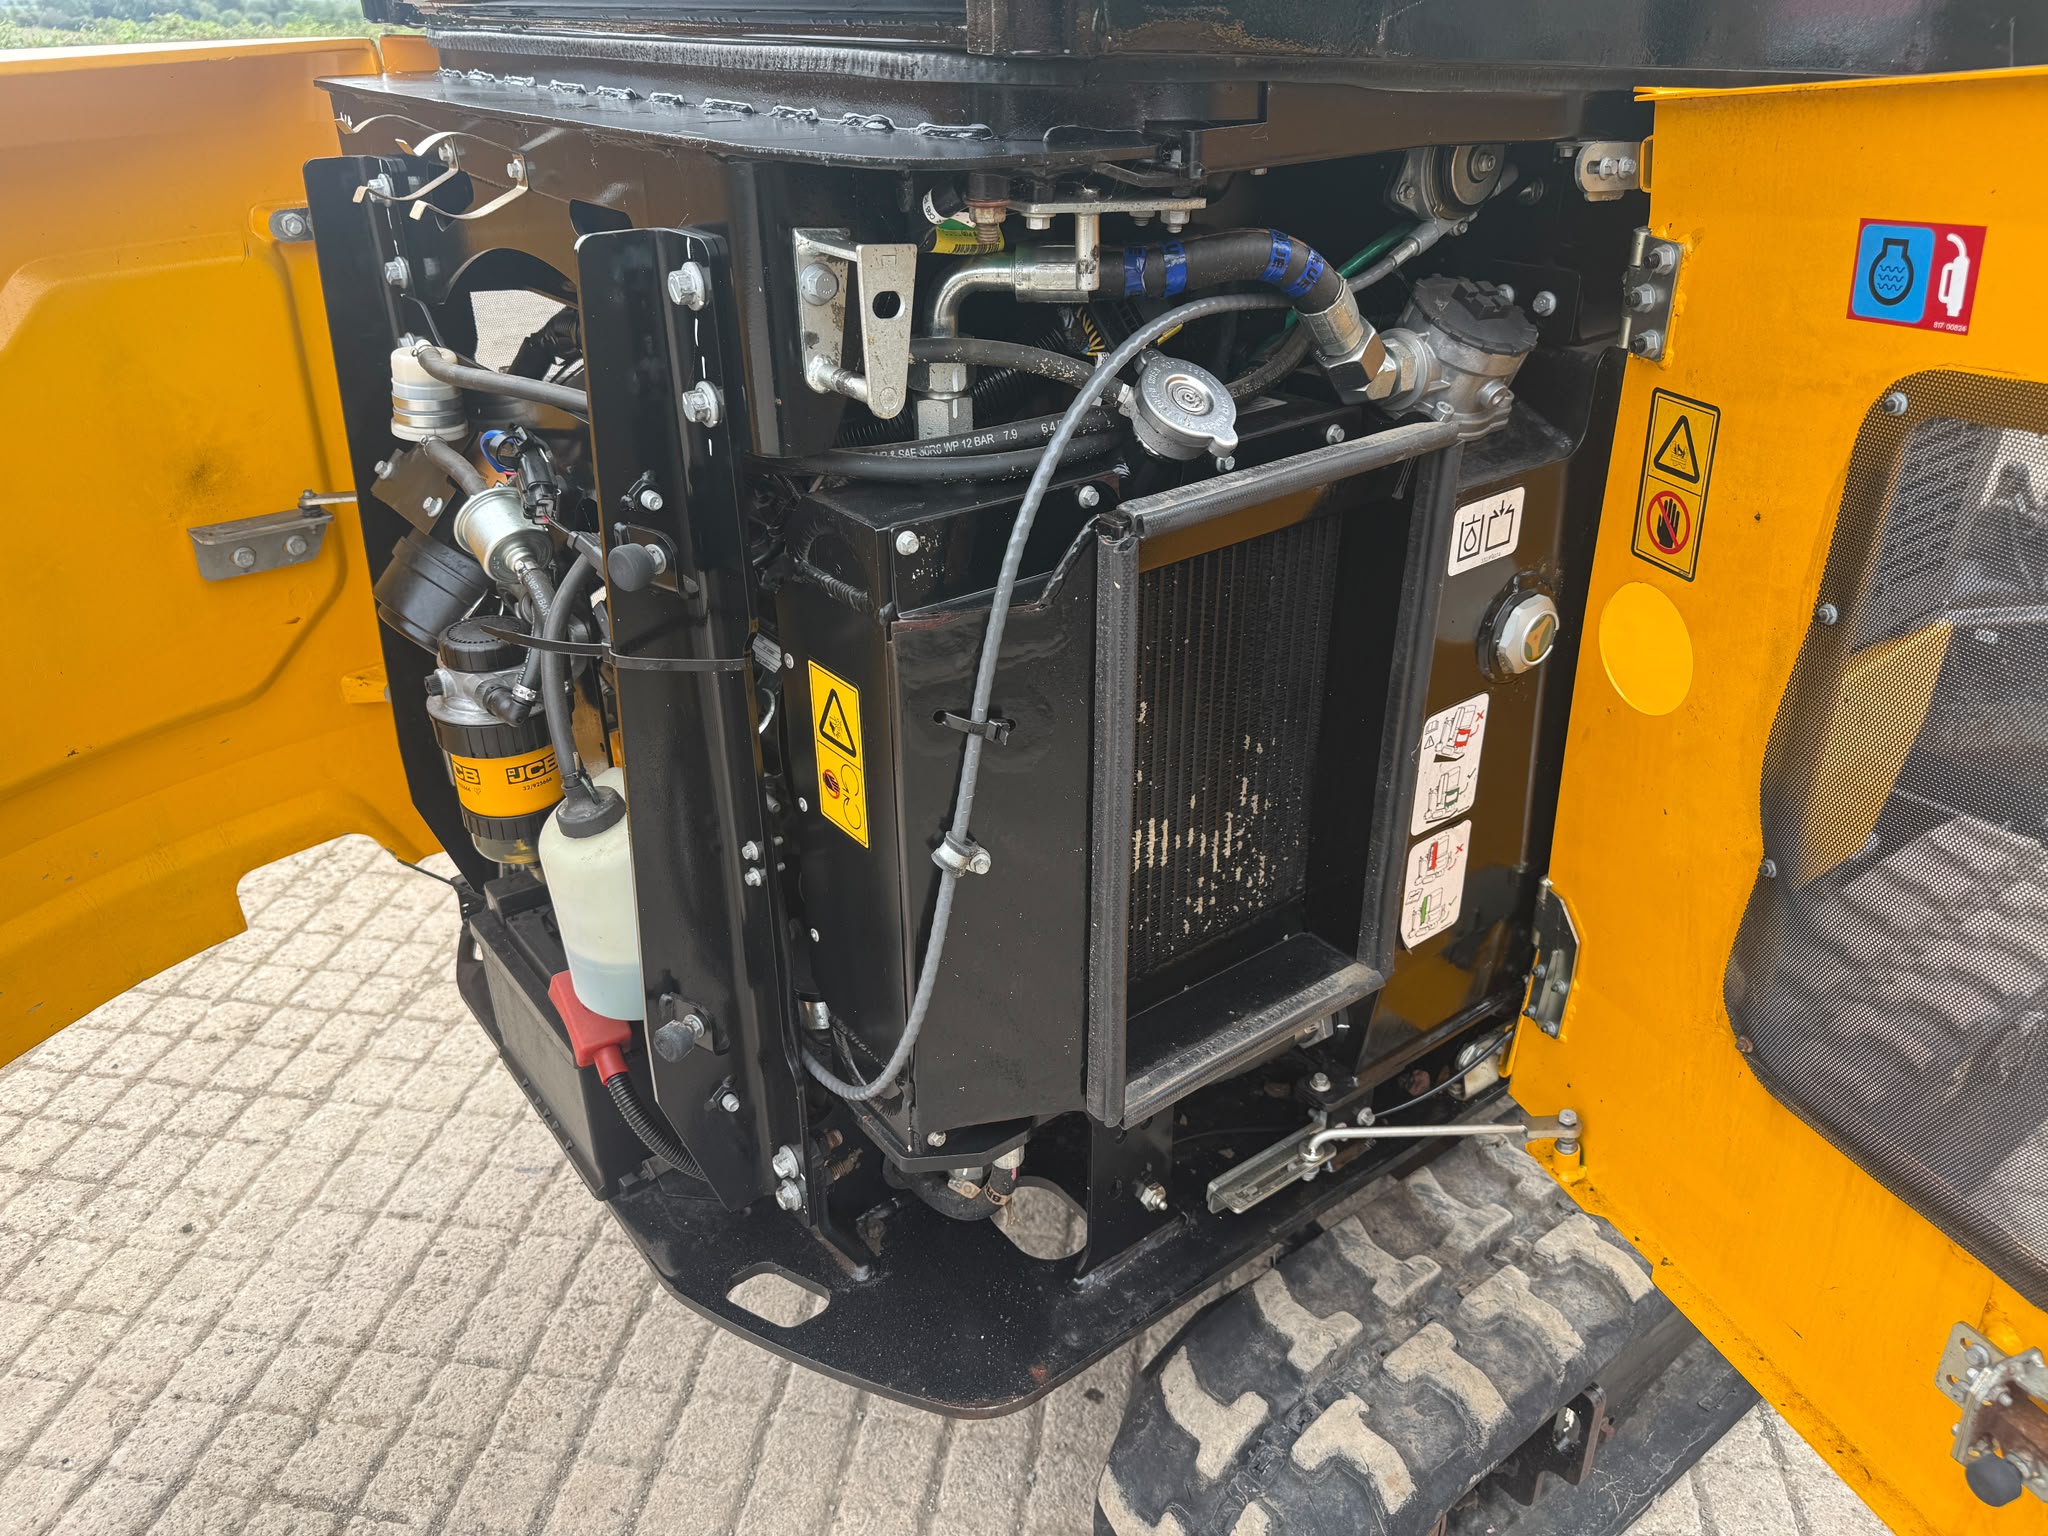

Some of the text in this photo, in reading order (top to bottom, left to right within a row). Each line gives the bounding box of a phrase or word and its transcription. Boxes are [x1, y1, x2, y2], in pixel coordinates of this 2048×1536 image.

[898, 447, 917, 459] SAE
[943, 440, 960, 454] WP
[961, 438, 973, 449] 12
[974, 433, 995, 447] BAR
[1003, 429, 1018, 441] 7.9
[1041, 420, 1062, 434] 64
[453, 762, 481, 785] CB
